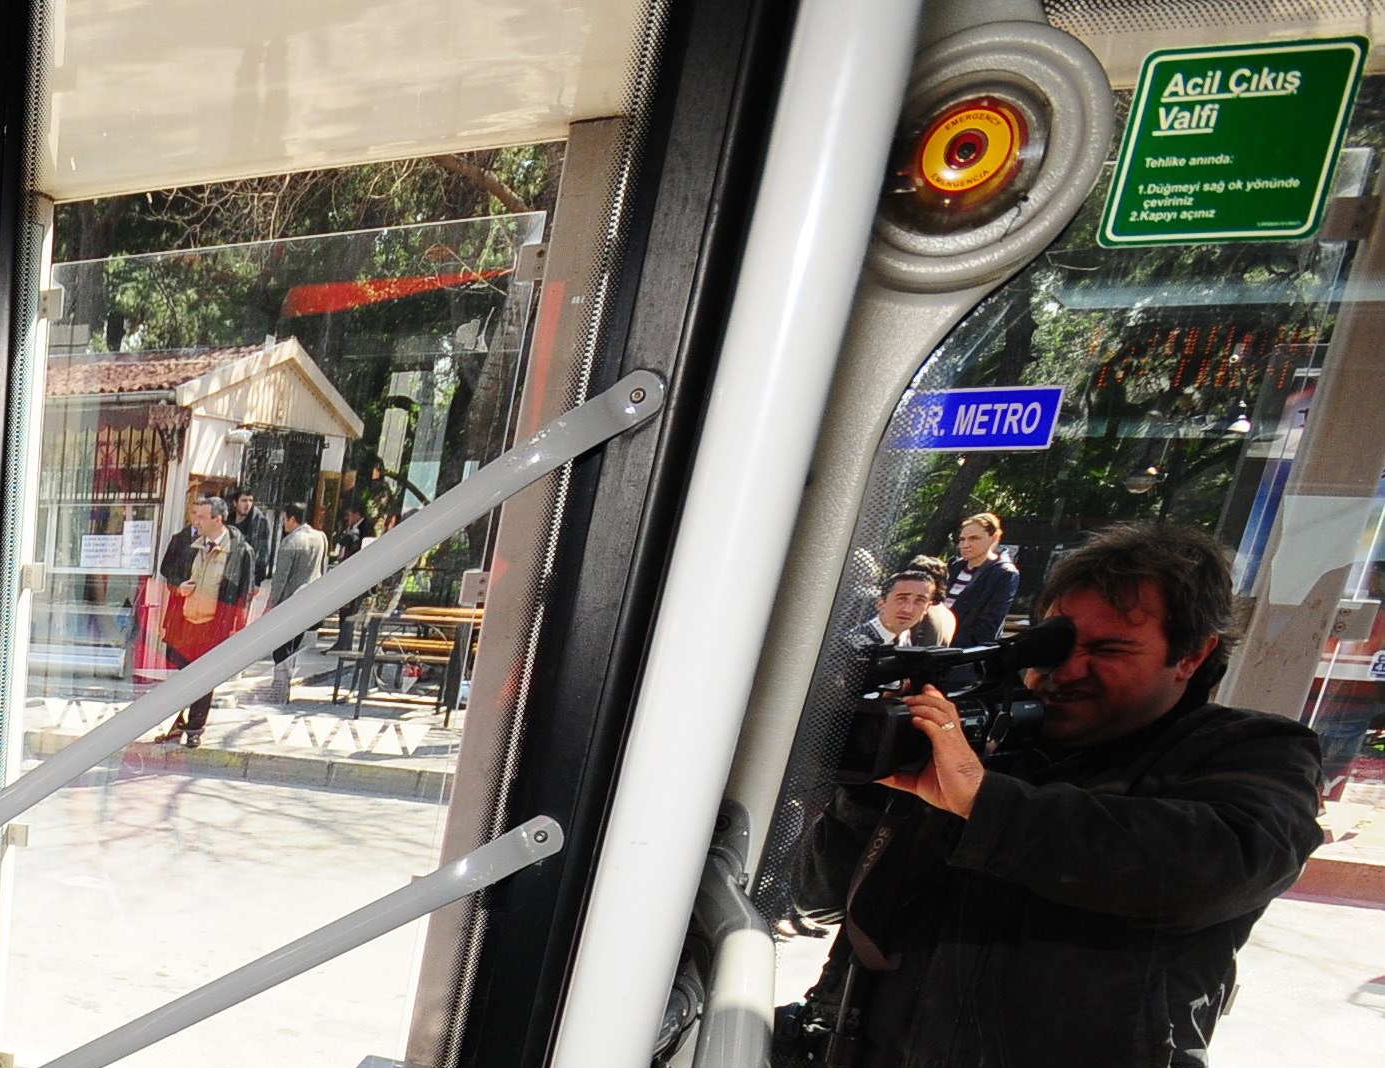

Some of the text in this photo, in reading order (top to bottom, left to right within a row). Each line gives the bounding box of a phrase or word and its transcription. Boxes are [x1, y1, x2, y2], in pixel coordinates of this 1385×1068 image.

[1162, 67, 1302, 97] Acil Çıkış
[944, 112, 1001, 131] EMERGENCY
[1158, 104, 1219, 131] Valfi
[1145, 154, 1234, 169] Tehlike anında:
[1137, 177, 1300, 195] 1.Düğmeyi sağ ok yönünde
[1143, 196, 1194, 210] çeviriniz
[1129, 209, 1216, 222] 2.Kapıyı açınız
[952, 401, 1042, 436] METRO
[862, 826, 891, 872] SONY
